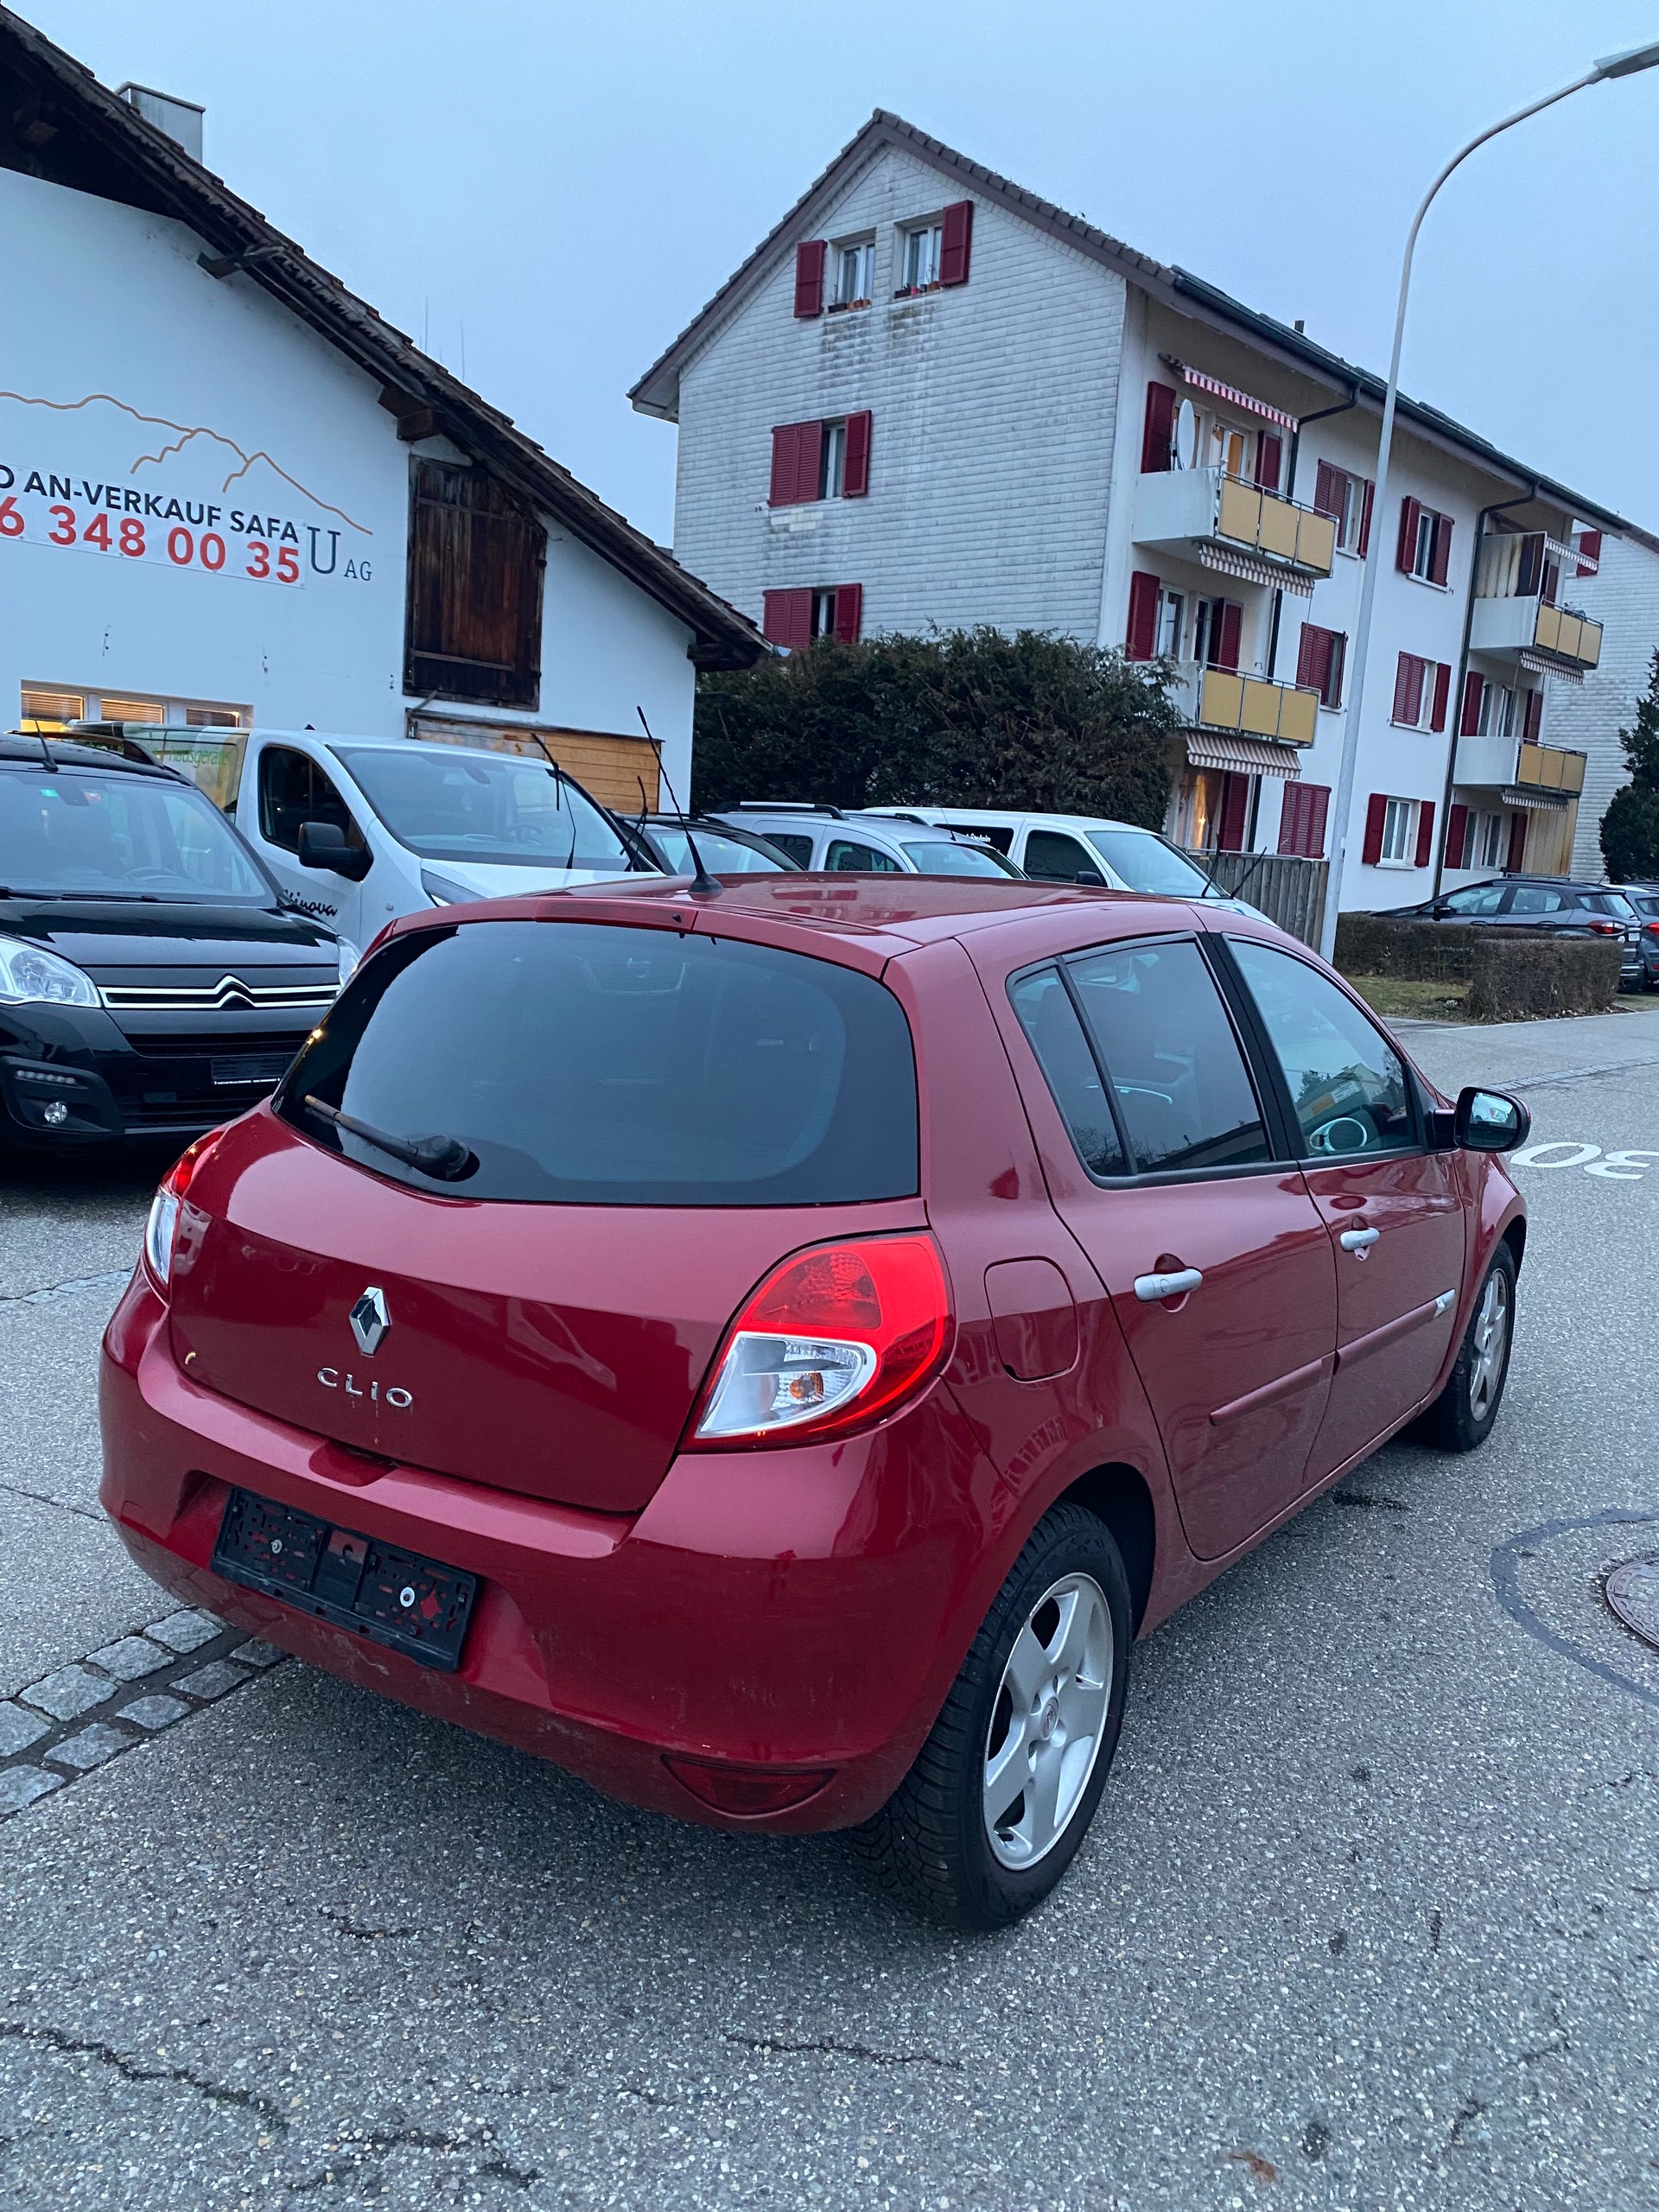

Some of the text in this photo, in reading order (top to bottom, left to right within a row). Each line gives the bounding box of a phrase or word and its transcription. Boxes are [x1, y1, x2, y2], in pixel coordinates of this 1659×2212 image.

[23, 471, 221, 527] AN-VERKAUF
[229, 510, 299, 543] SAFA
[48, 505, 146, 557] 348
[168, 527, 226, 570] 00
[246, 542, 299, 583] 35
[344, 559, 372, 582] AG
[1510, 1141, 1659, 1180] 30
[317, 1367, 413, 1408] CLIO
